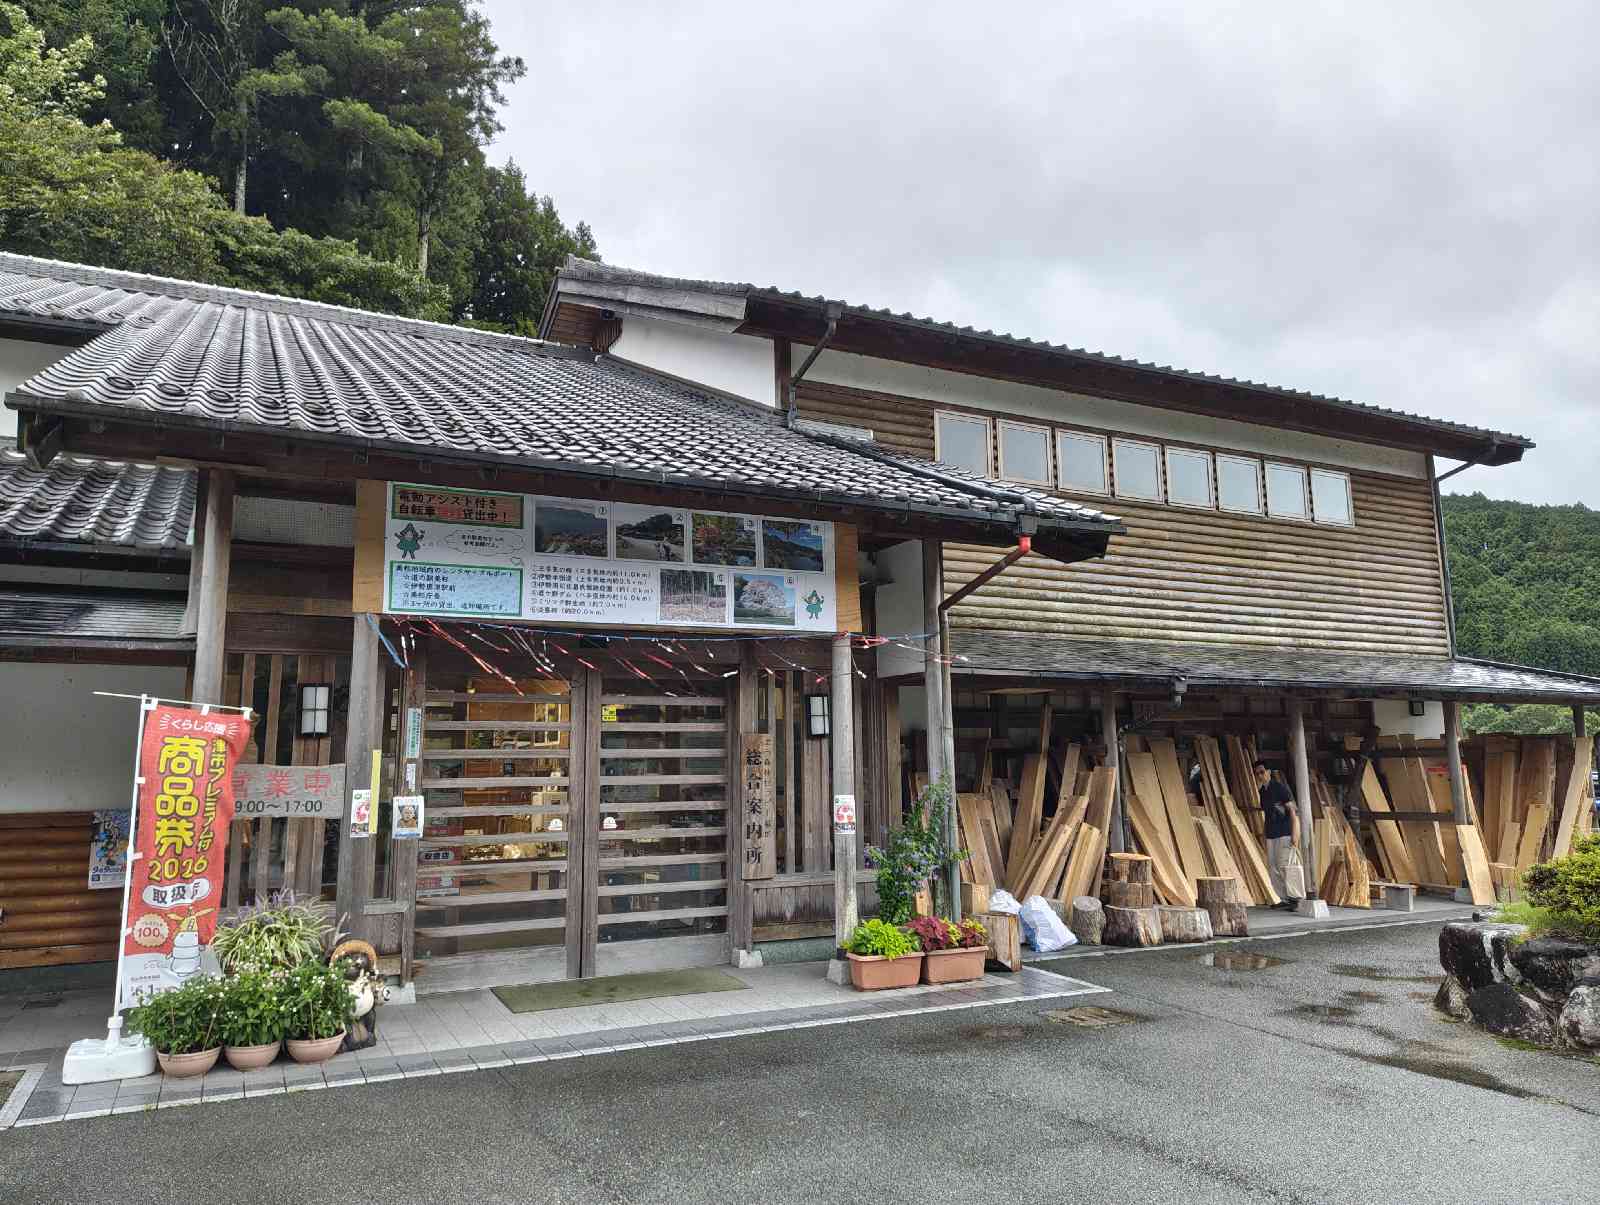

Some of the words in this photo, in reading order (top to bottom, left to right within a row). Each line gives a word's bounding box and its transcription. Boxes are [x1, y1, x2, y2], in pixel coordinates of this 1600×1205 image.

[171, 718, 226, 735] くらし応援
[154, 735, 208, 857] 商品券
